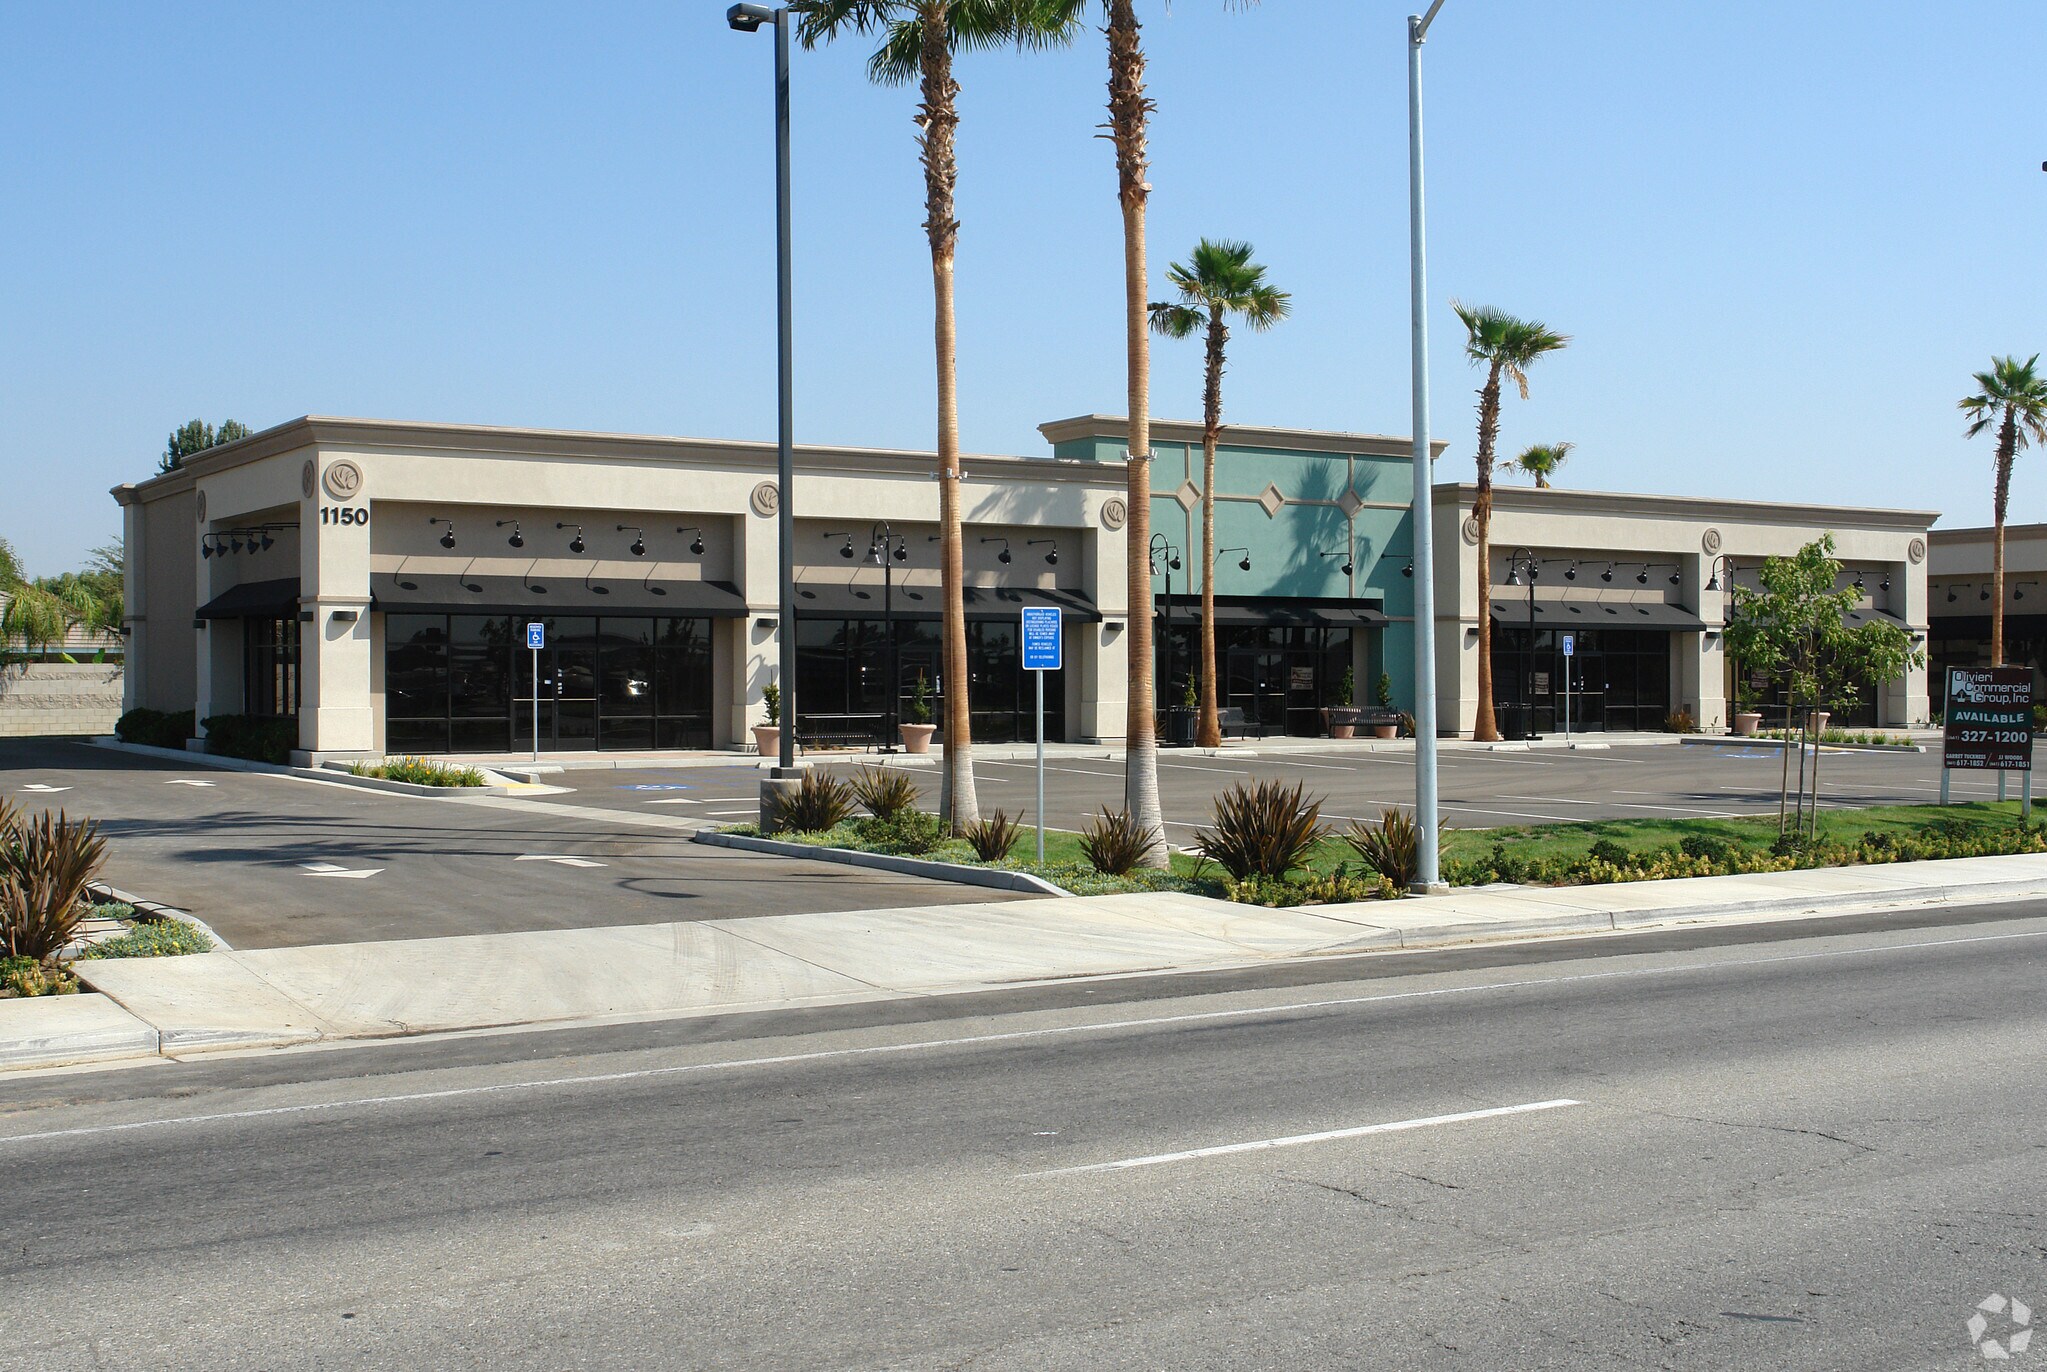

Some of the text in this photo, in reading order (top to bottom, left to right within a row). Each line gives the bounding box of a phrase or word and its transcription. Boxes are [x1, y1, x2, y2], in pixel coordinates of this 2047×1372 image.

[320, 506, 369, 526] 1150
[1954, 671, 1993, 682] Olivieri
[1964, 682, 2031, 693] Commercial
[1974, 692, 2029, 705] Group, Inc
[1955, 711, 2025, 724] AVAILABLE
[1961, 730, 2028, 743] 327-1200
